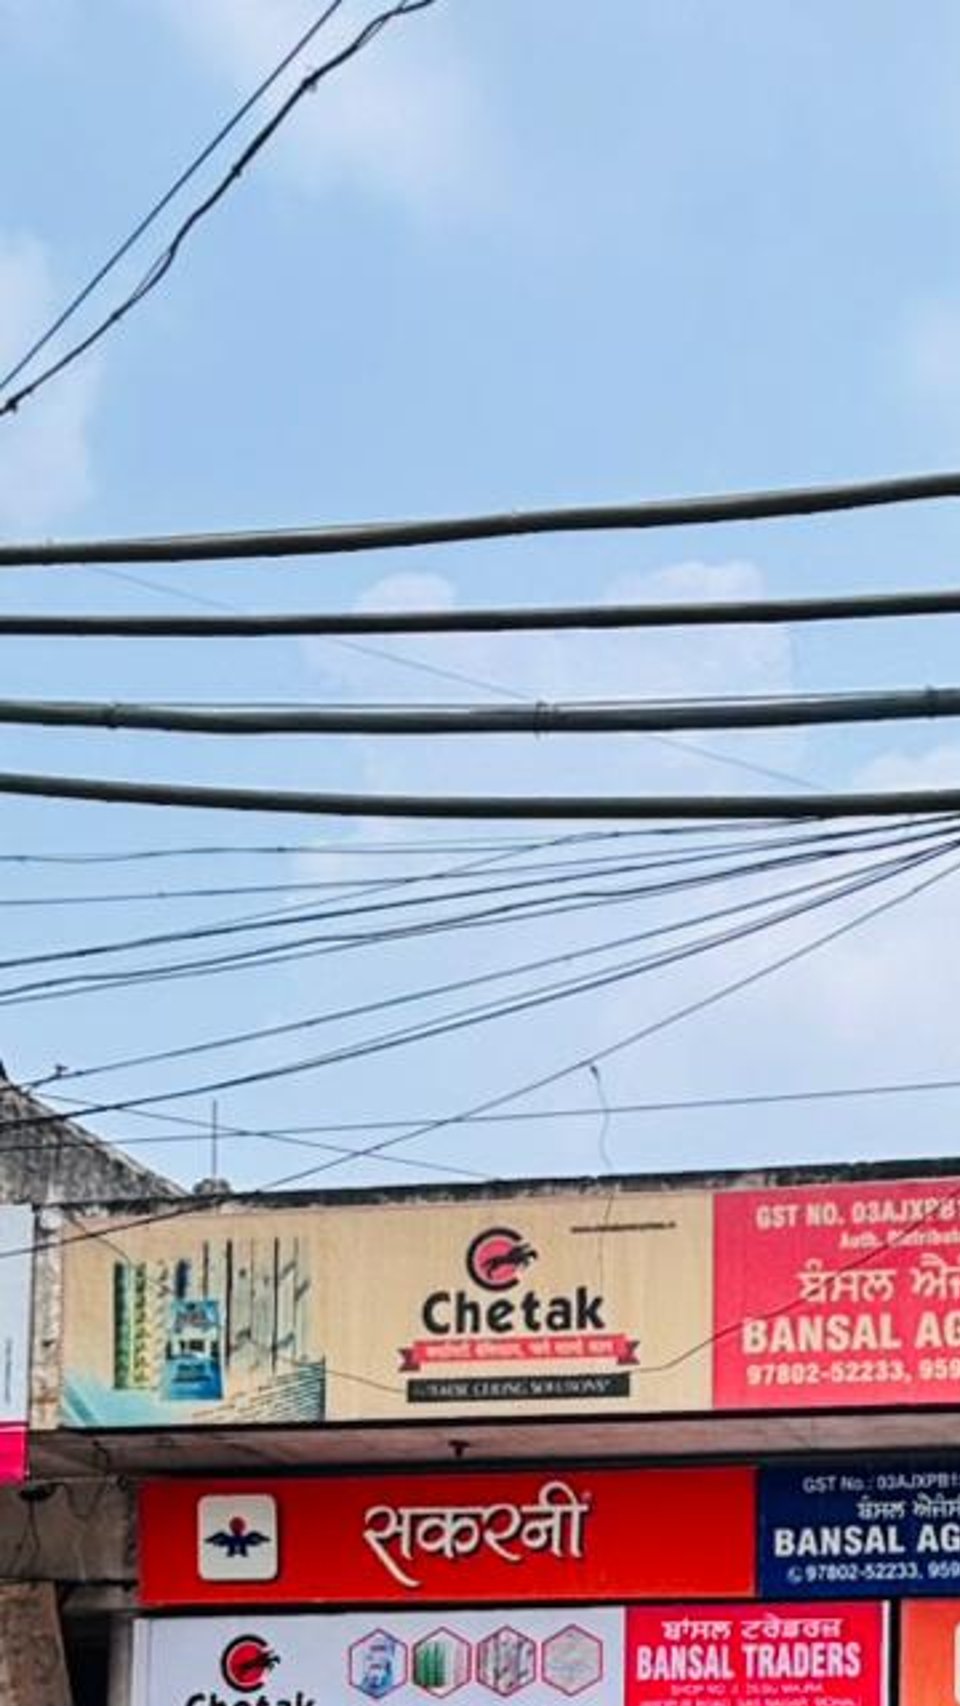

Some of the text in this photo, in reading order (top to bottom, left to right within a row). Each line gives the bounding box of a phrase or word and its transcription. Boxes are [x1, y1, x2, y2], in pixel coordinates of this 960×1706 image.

[756, 1205, 799, 1229] GST
[807, 1204, 844, 1227] NO.
[422, 1286, 606, 1335] Chetak
[742, 1313, 902, 1355] BANSAL
[745, 1360, 912, 1386] 97802-52233,
[802, 1475, 837, 1492] GST
[362, 1480, 589, 1588] सकरनी
[774, 1524, 906, 1558] BANSAL
[636, 1641, 862, 1682] BANSAL TRADERS
